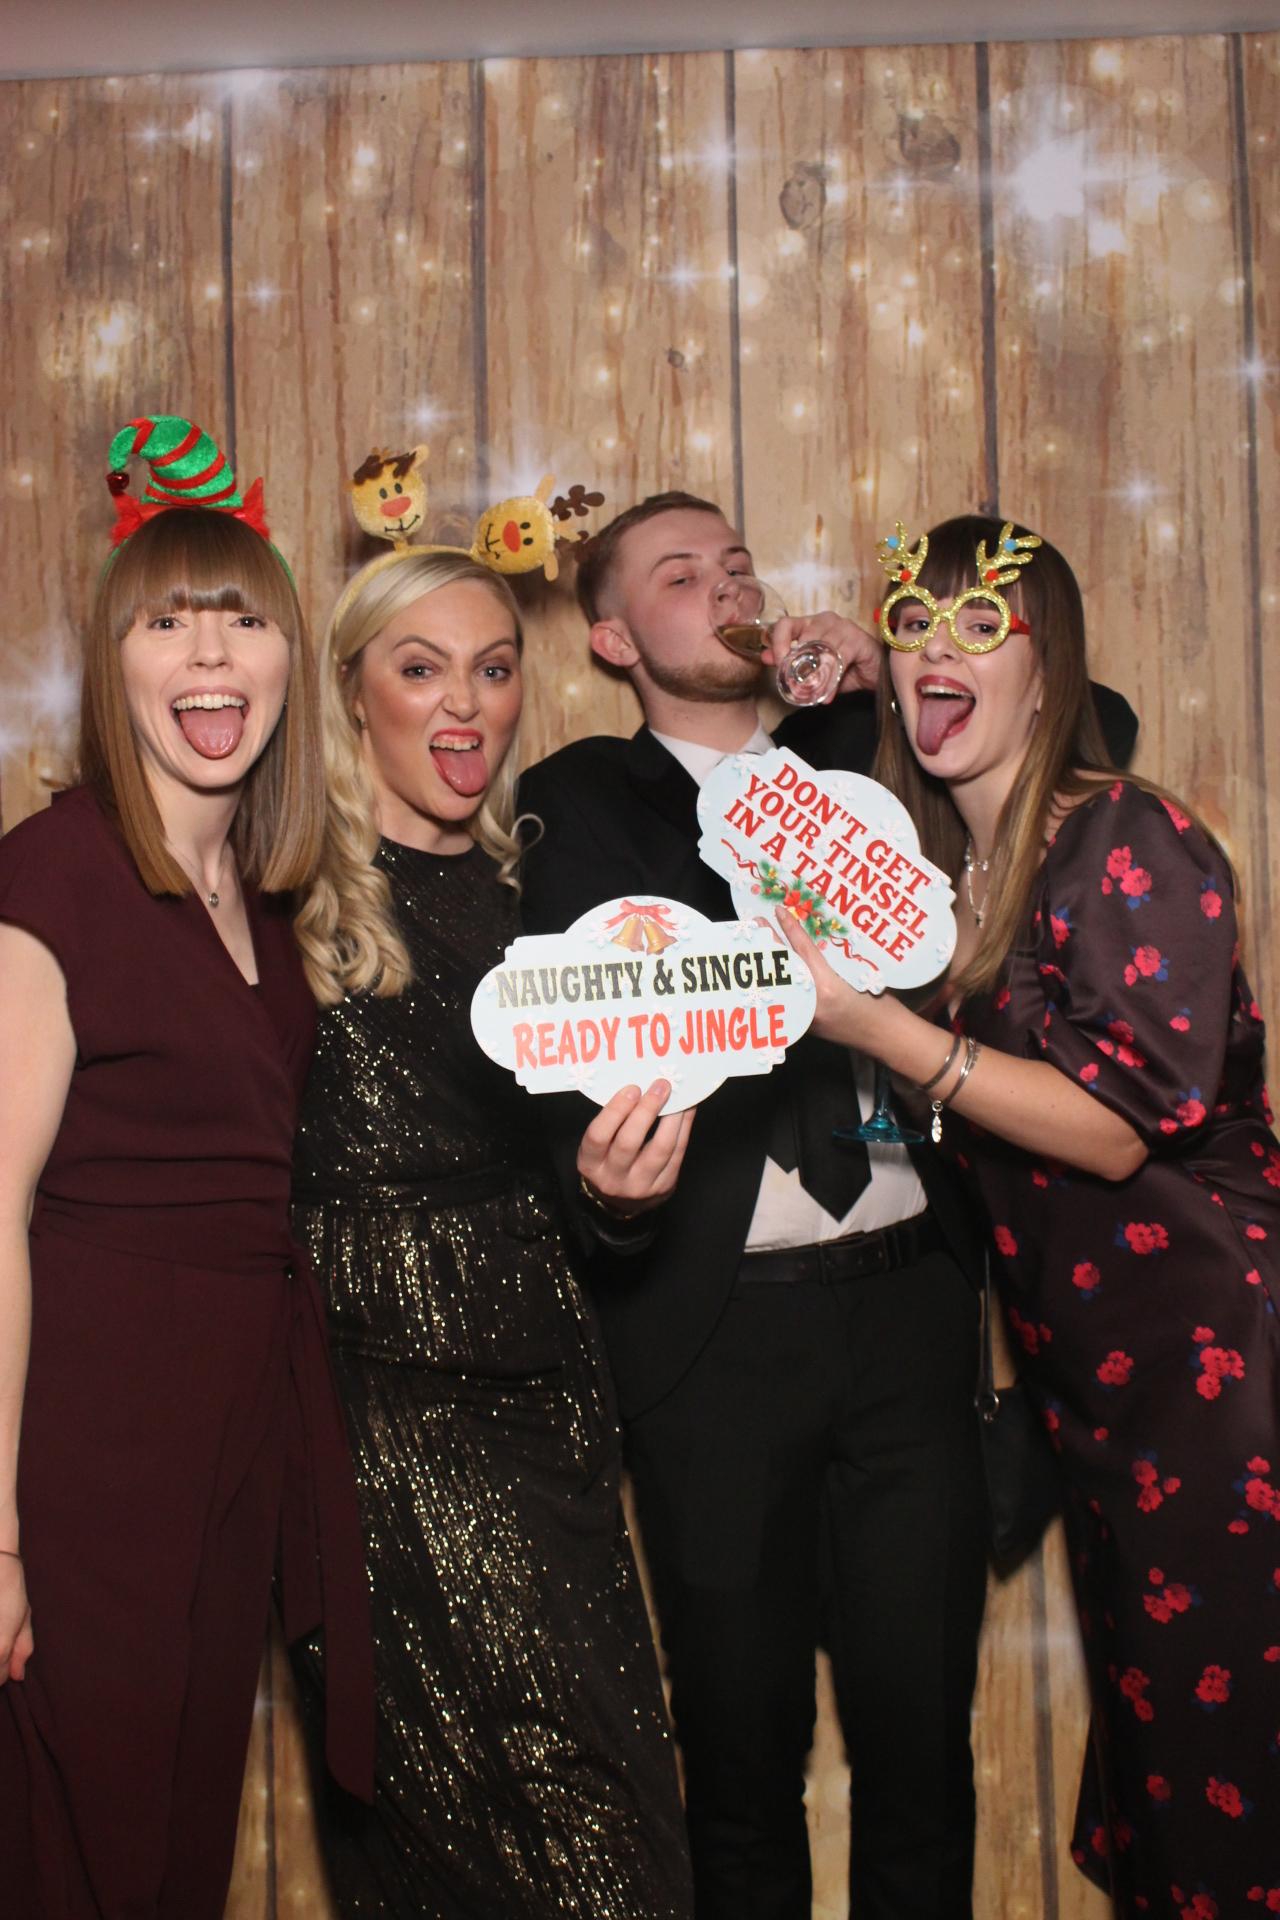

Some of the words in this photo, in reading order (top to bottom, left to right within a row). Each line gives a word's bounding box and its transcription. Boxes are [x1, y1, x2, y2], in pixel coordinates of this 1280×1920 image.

[724, 799, 765, 838] IN
[760, 832, 788, 862] A
[791, 851, 914, 962] TANGLE
[744, 774, 821, 850] YOUR
[824, 840, 928, 940] TINSEL
[772, 763, 868, 845] DON'T
[865, 839, 931, 896] GET
[495, 961, 643, 1008] NAUGHTY
[653, 959, 675, 996] &
[681, 950, 792, 994] SINGLE
[513, 1016, 621, 1069] READY
[628, 1013, 671, 1058] TO
[679, 1004, 788, 1055] JINGLE
